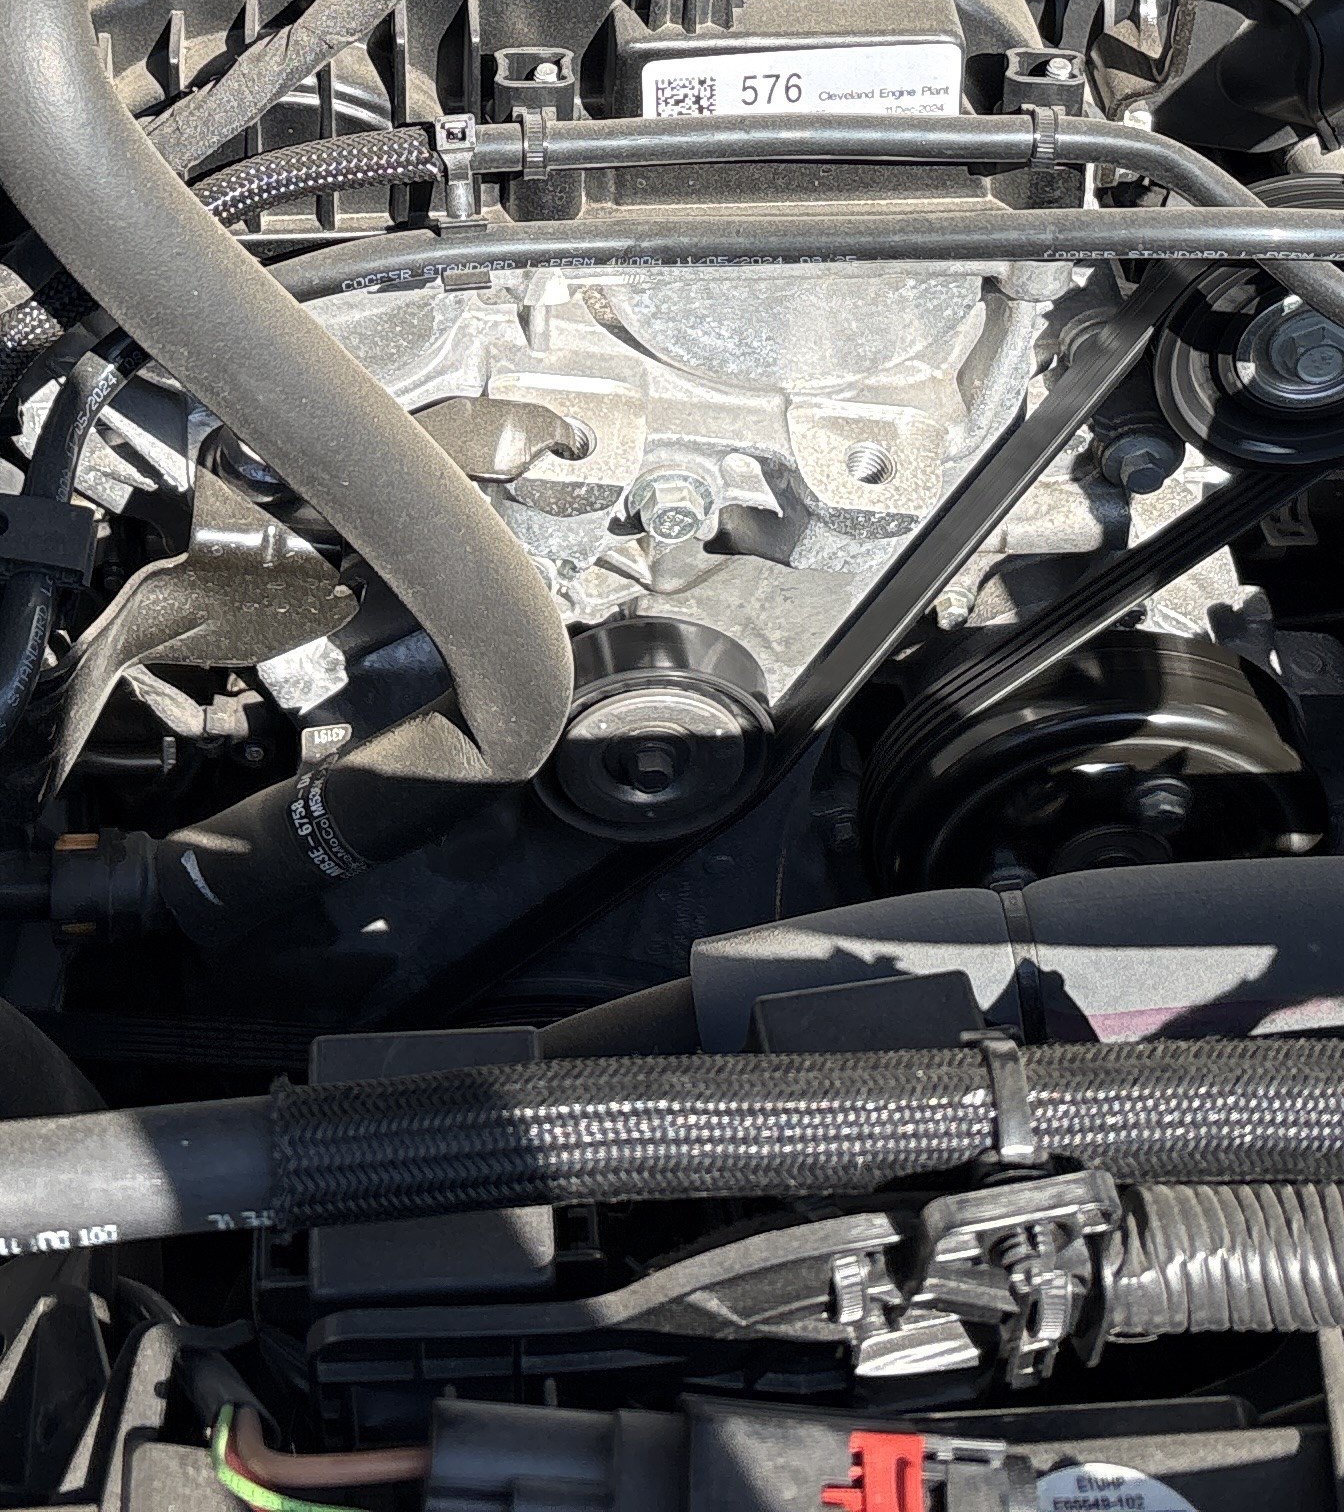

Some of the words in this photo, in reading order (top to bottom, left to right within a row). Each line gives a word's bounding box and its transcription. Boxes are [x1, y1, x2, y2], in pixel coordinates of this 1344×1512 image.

[741, 72, 803, 106] 576
[818, 89, 875, 102] Cleveland
[879, 86, 917, 100] Engine
[921, 85, 950, 97] Plant
[341, 269, 412, 292] COOPER
[6, 604, 48, 708] STANDARD
[79, 1224, 118, 1247] DOT
